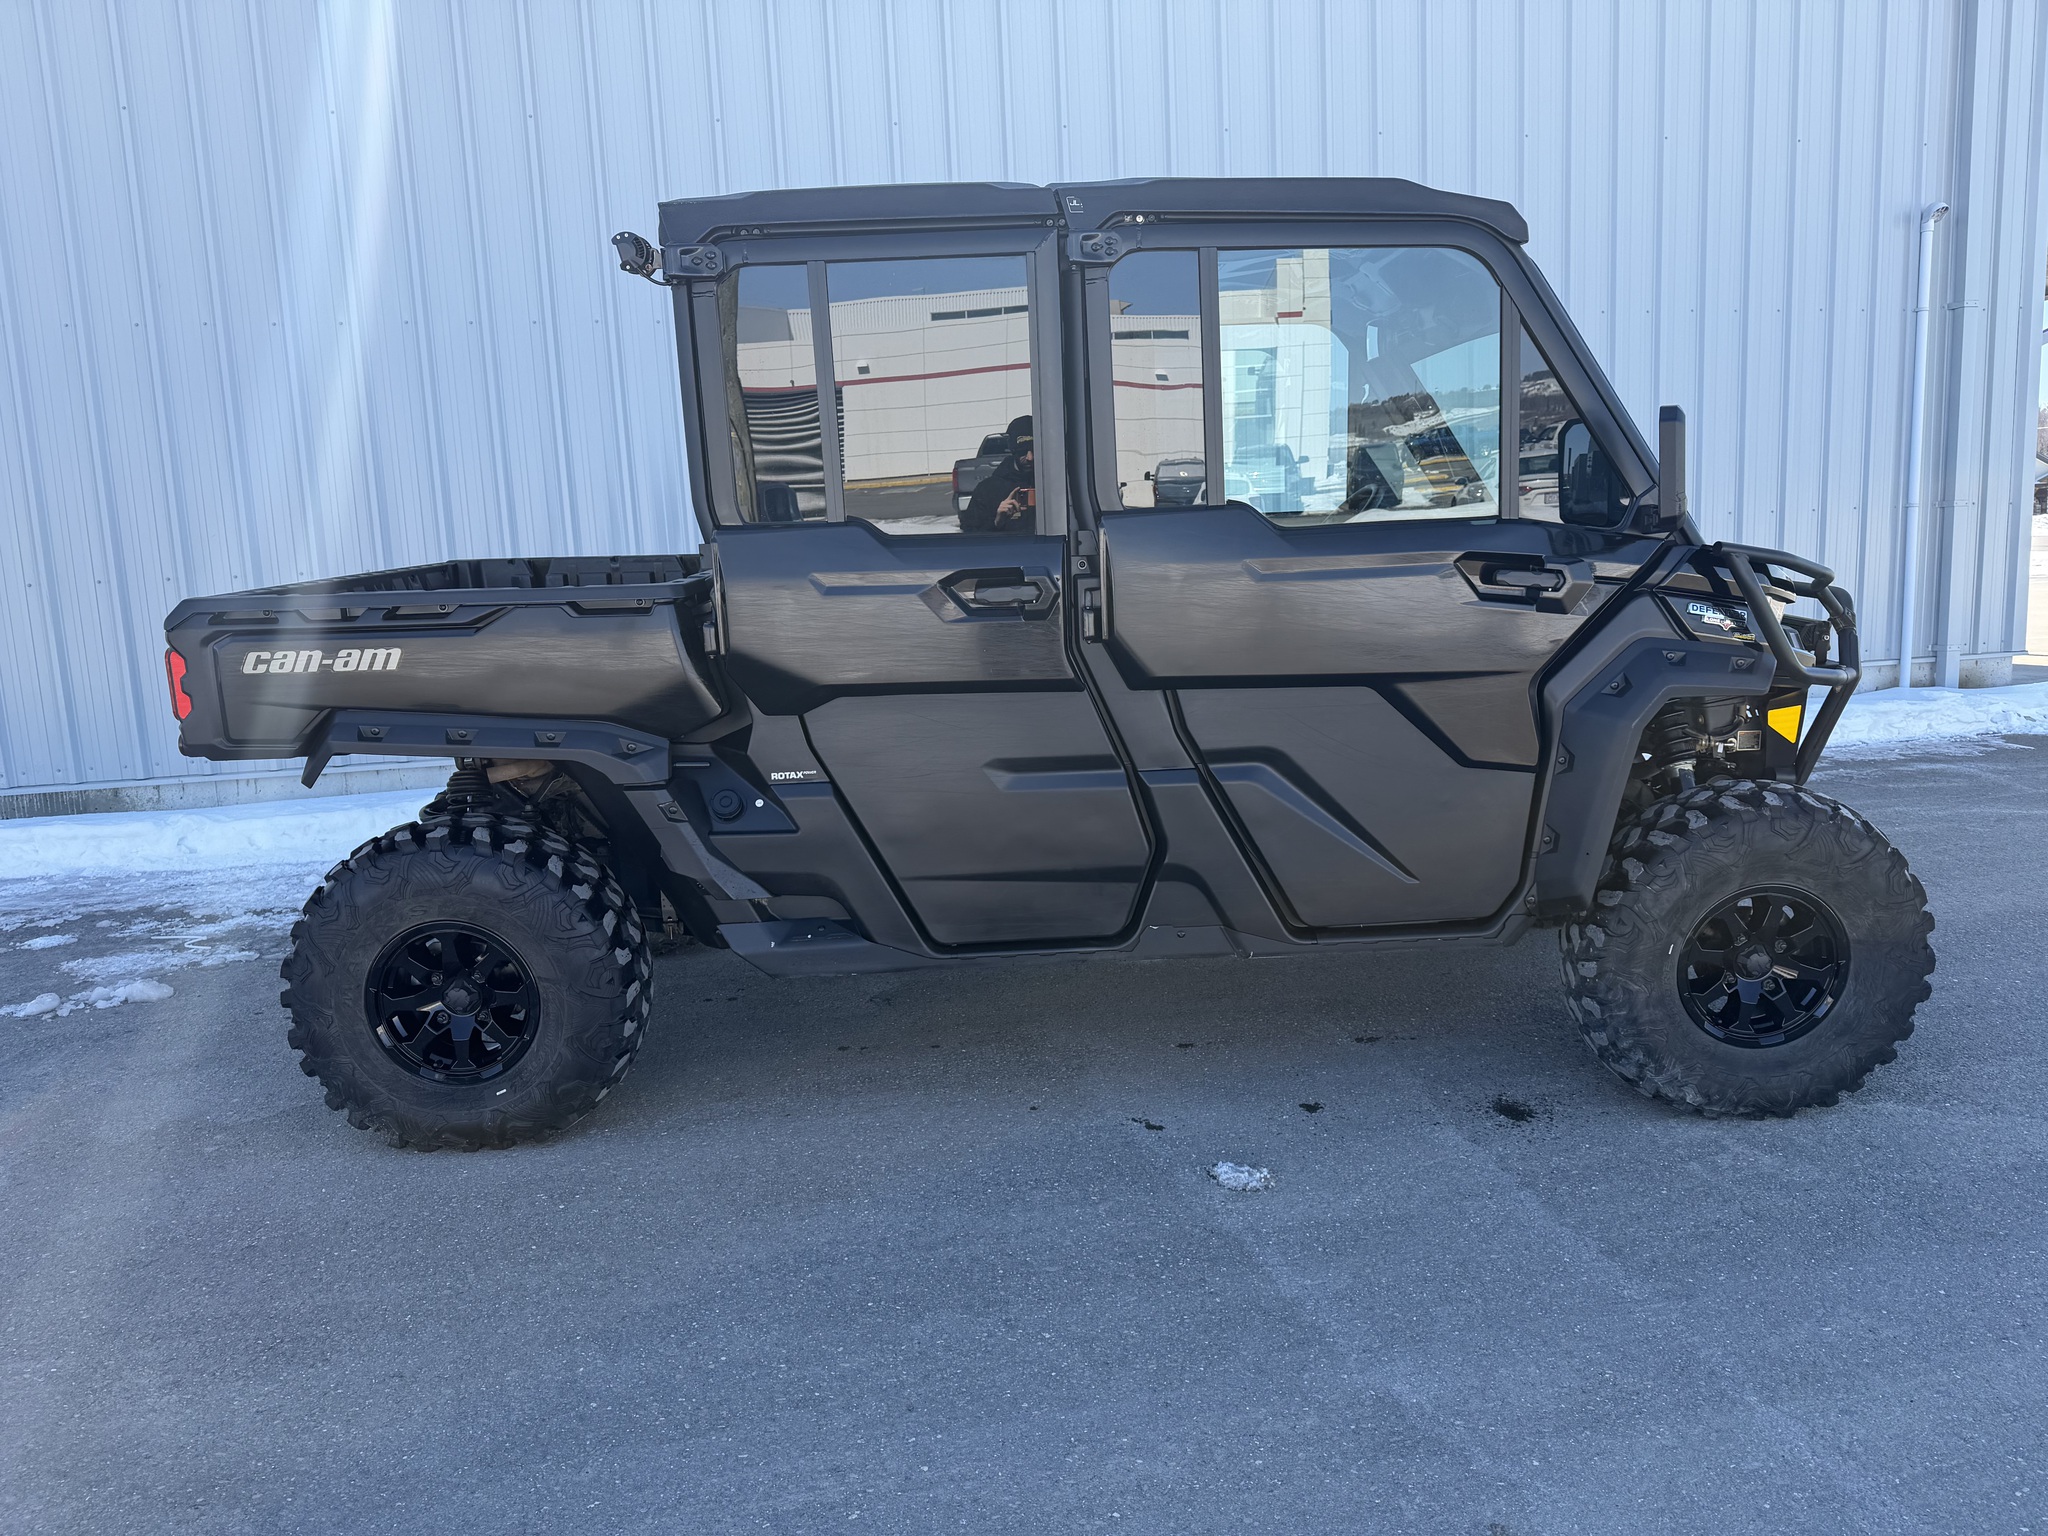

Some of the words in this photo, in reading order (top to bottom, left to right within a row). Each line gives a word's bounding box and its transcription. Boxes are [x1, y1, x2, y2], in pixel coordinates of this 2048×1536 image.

[1691, 604, 1746, 619] DEFER
[242, 648, 401, 674] can-am
[771, 770, 804, 780] ROTAX
